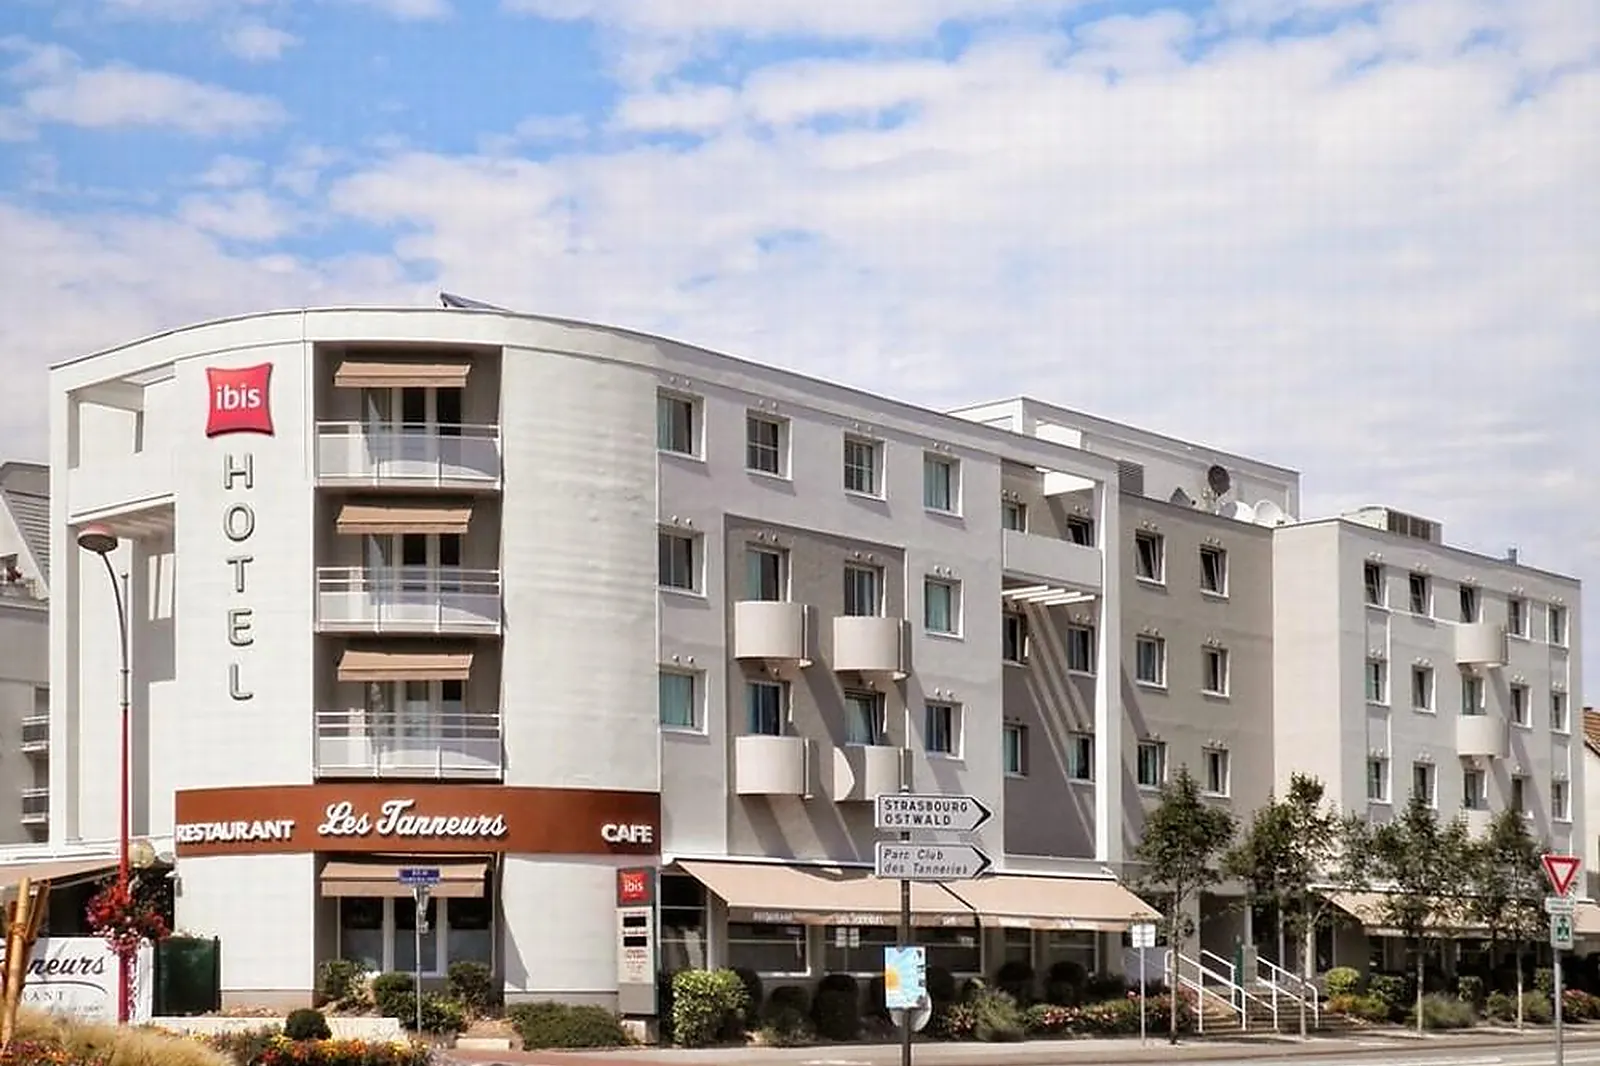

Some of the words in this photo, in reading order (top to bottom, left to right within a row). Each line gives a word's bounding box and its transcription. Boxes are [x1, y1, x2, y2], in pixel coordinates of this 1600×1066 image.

[216, 383, 261, 410] ibis
[223, 452, 255, 701] HOTEL
[884, 800, 968, 812] STRASBOURG
[318, 801, 372, 835] Les
[376, 799, 507, 837] Tanneurs
[884, 813, 952, 826] OSTWALD
[176, 820, 295, 844] RESTAURANT
[883, 848, 910, 860] Parc
[917, 848, 944, 861] Club
[884, 862, 905, 874] des
[913, 862, 968, 875] Tanneries
[624, 880, 644, 893] ibis
[26, 956, 105, 976] neurs
